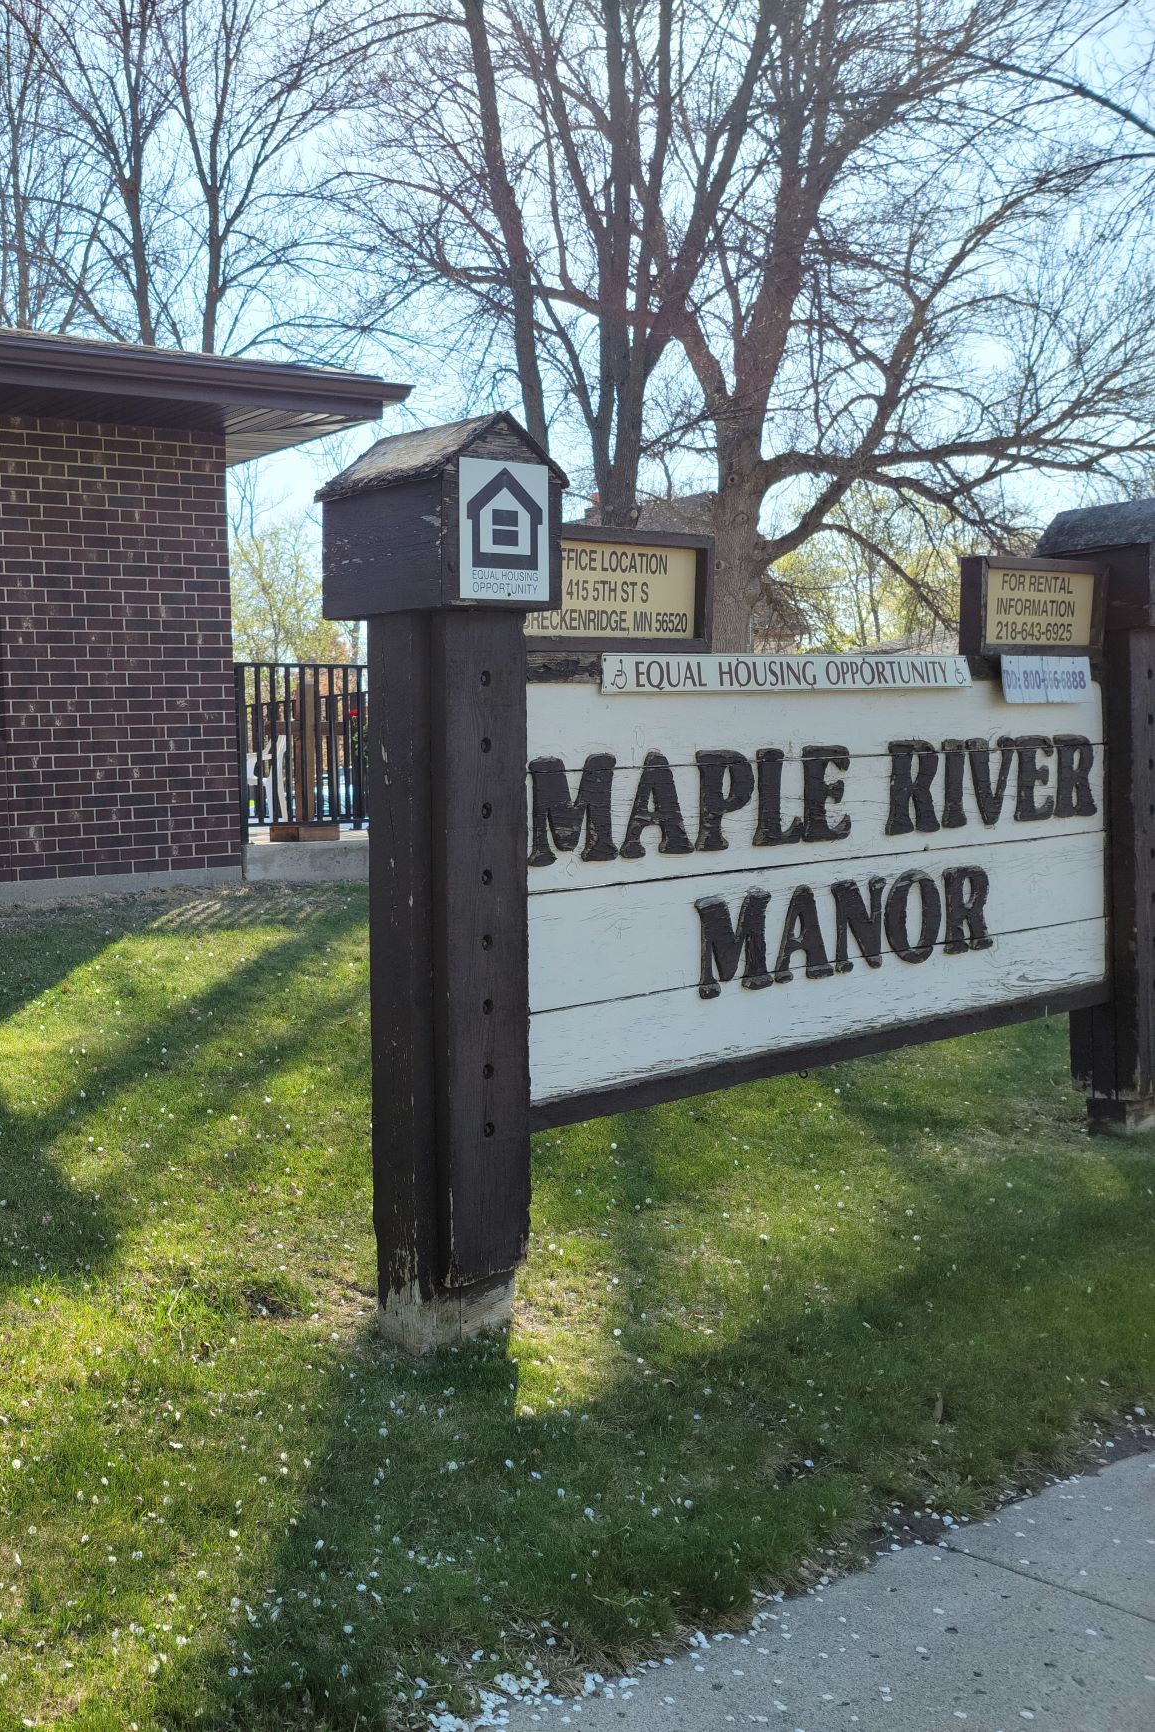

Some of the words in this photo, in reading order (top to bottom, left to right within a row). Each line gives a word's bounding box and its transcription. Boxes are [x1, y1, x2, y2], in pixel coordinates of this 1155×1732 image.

[562, 548, 597, 571] FICE
[601, 550, 668, 575] LOCATION
[472, 569, 499, 580] EQUAL
[501, 571, 539, 582] HOUSING
[1001, 573, 1026, 592] FOR
[1028, 575, 1074, 594] RENTAL
[472, 581, 538, 594] OPPORTUNITY
[566, 579, 589, 601] 415
[592, 580, 617, 602] 5TH
[620, 581, 637, 603] ST
[640, 582, 649, 603] S
[996, 597, 1076, 618] INFORMATION
[633, 611, 653, 632] MN
[654, 612, 688, 633] 56520
[995, 621, 1073, 642] 218-643-6925
[634, 660, 708, 690] EQUAL
[718, 660, 817, 687] HOUSING
[825, 660, 948, 686] OPPORTUNITY
[528, 745, 852, 867] MAPLE
[885, 734, 1098, 836] RIVER
[694, 865, 994, 1000] MANOR
